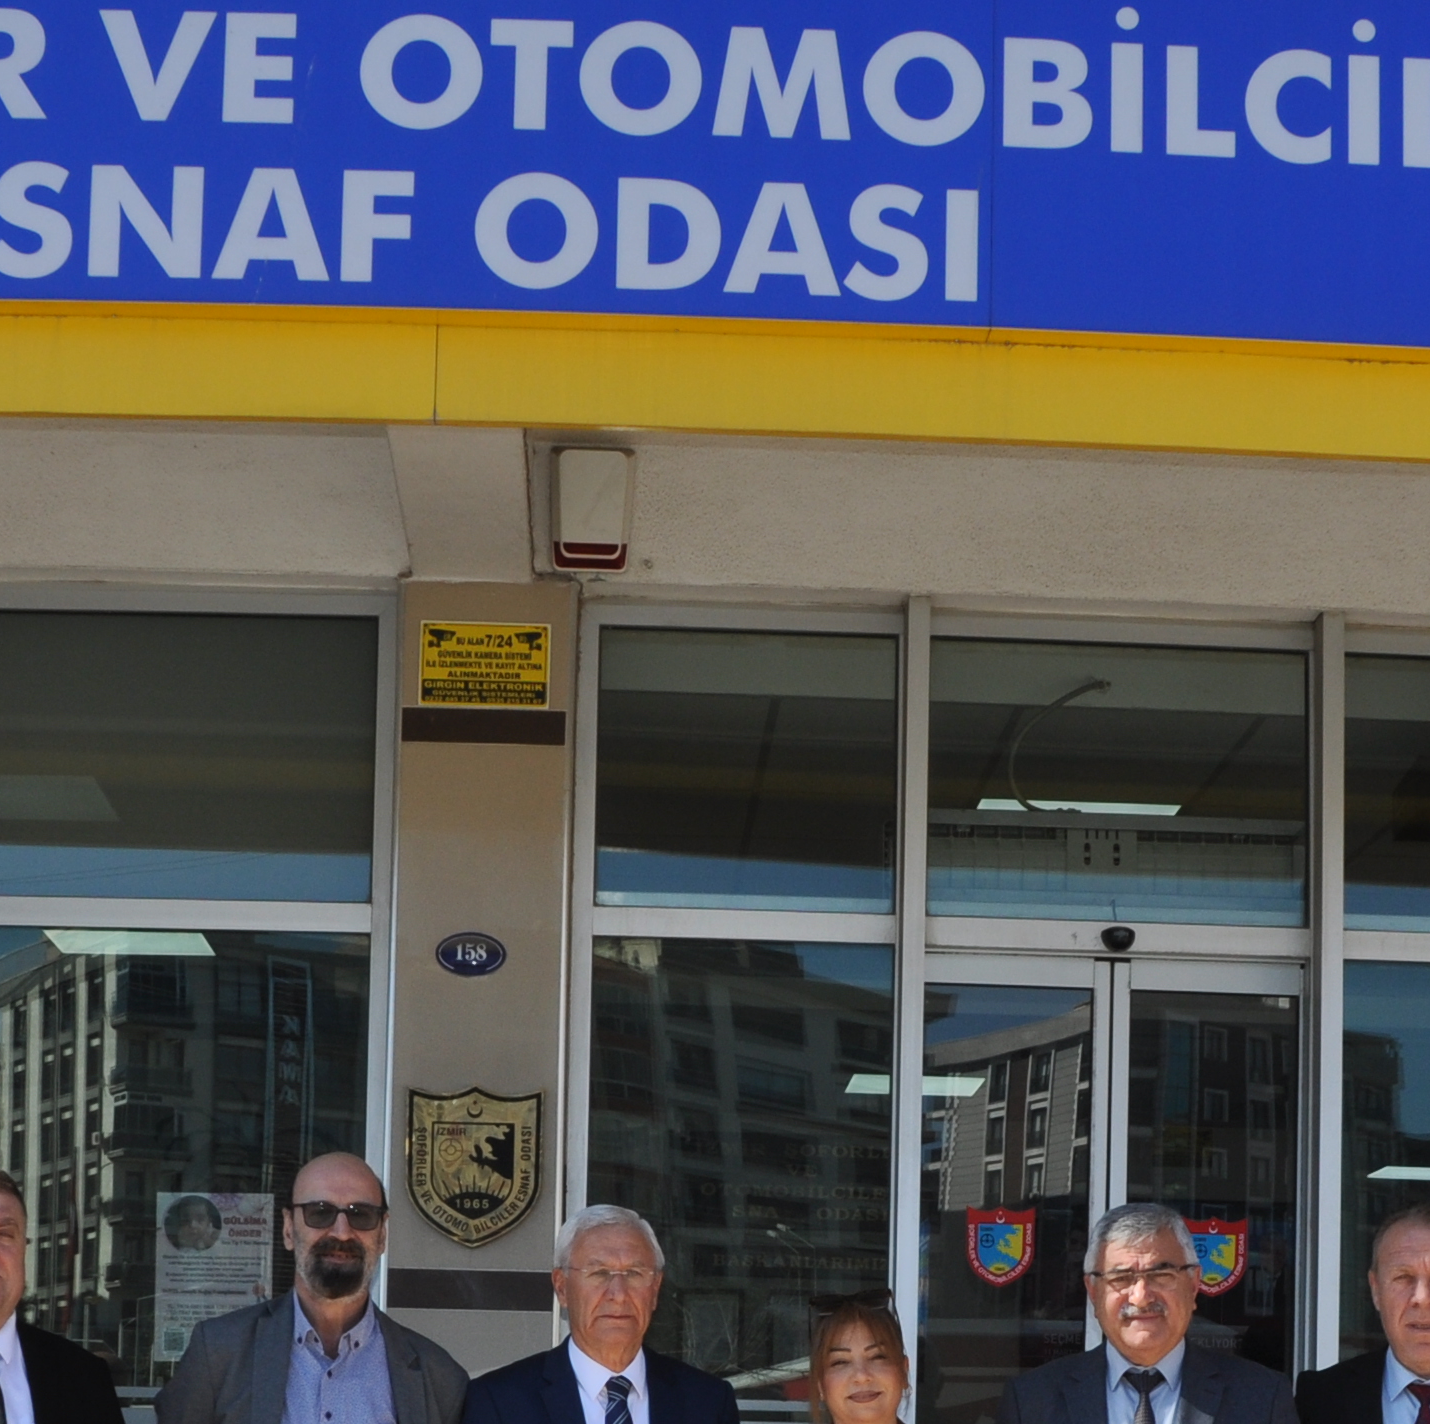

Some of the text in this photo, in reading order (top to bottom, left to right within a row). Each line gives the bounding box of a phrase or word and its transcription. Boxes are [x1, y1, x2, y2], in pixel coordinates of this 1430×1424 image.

[100, 10, 297, 124] VE
[475, 173, 979, 302] ODASI
[484, 634, 513, 648] 7/24
[437, 649, 472, 658] GÜVENLİK
[474, 651, 503, 660] KAMERA
[447, 670, 521, 680] ALINMAKTADIR
[455, 943, 487, 961] 158
[436, 1125, 467, 1137] İZMİR
[520, 1126, 532, 1162] ODASI
[514, 1168, 532, 1204] ESNAF
[455, 1198, 490, 1209] 1965
